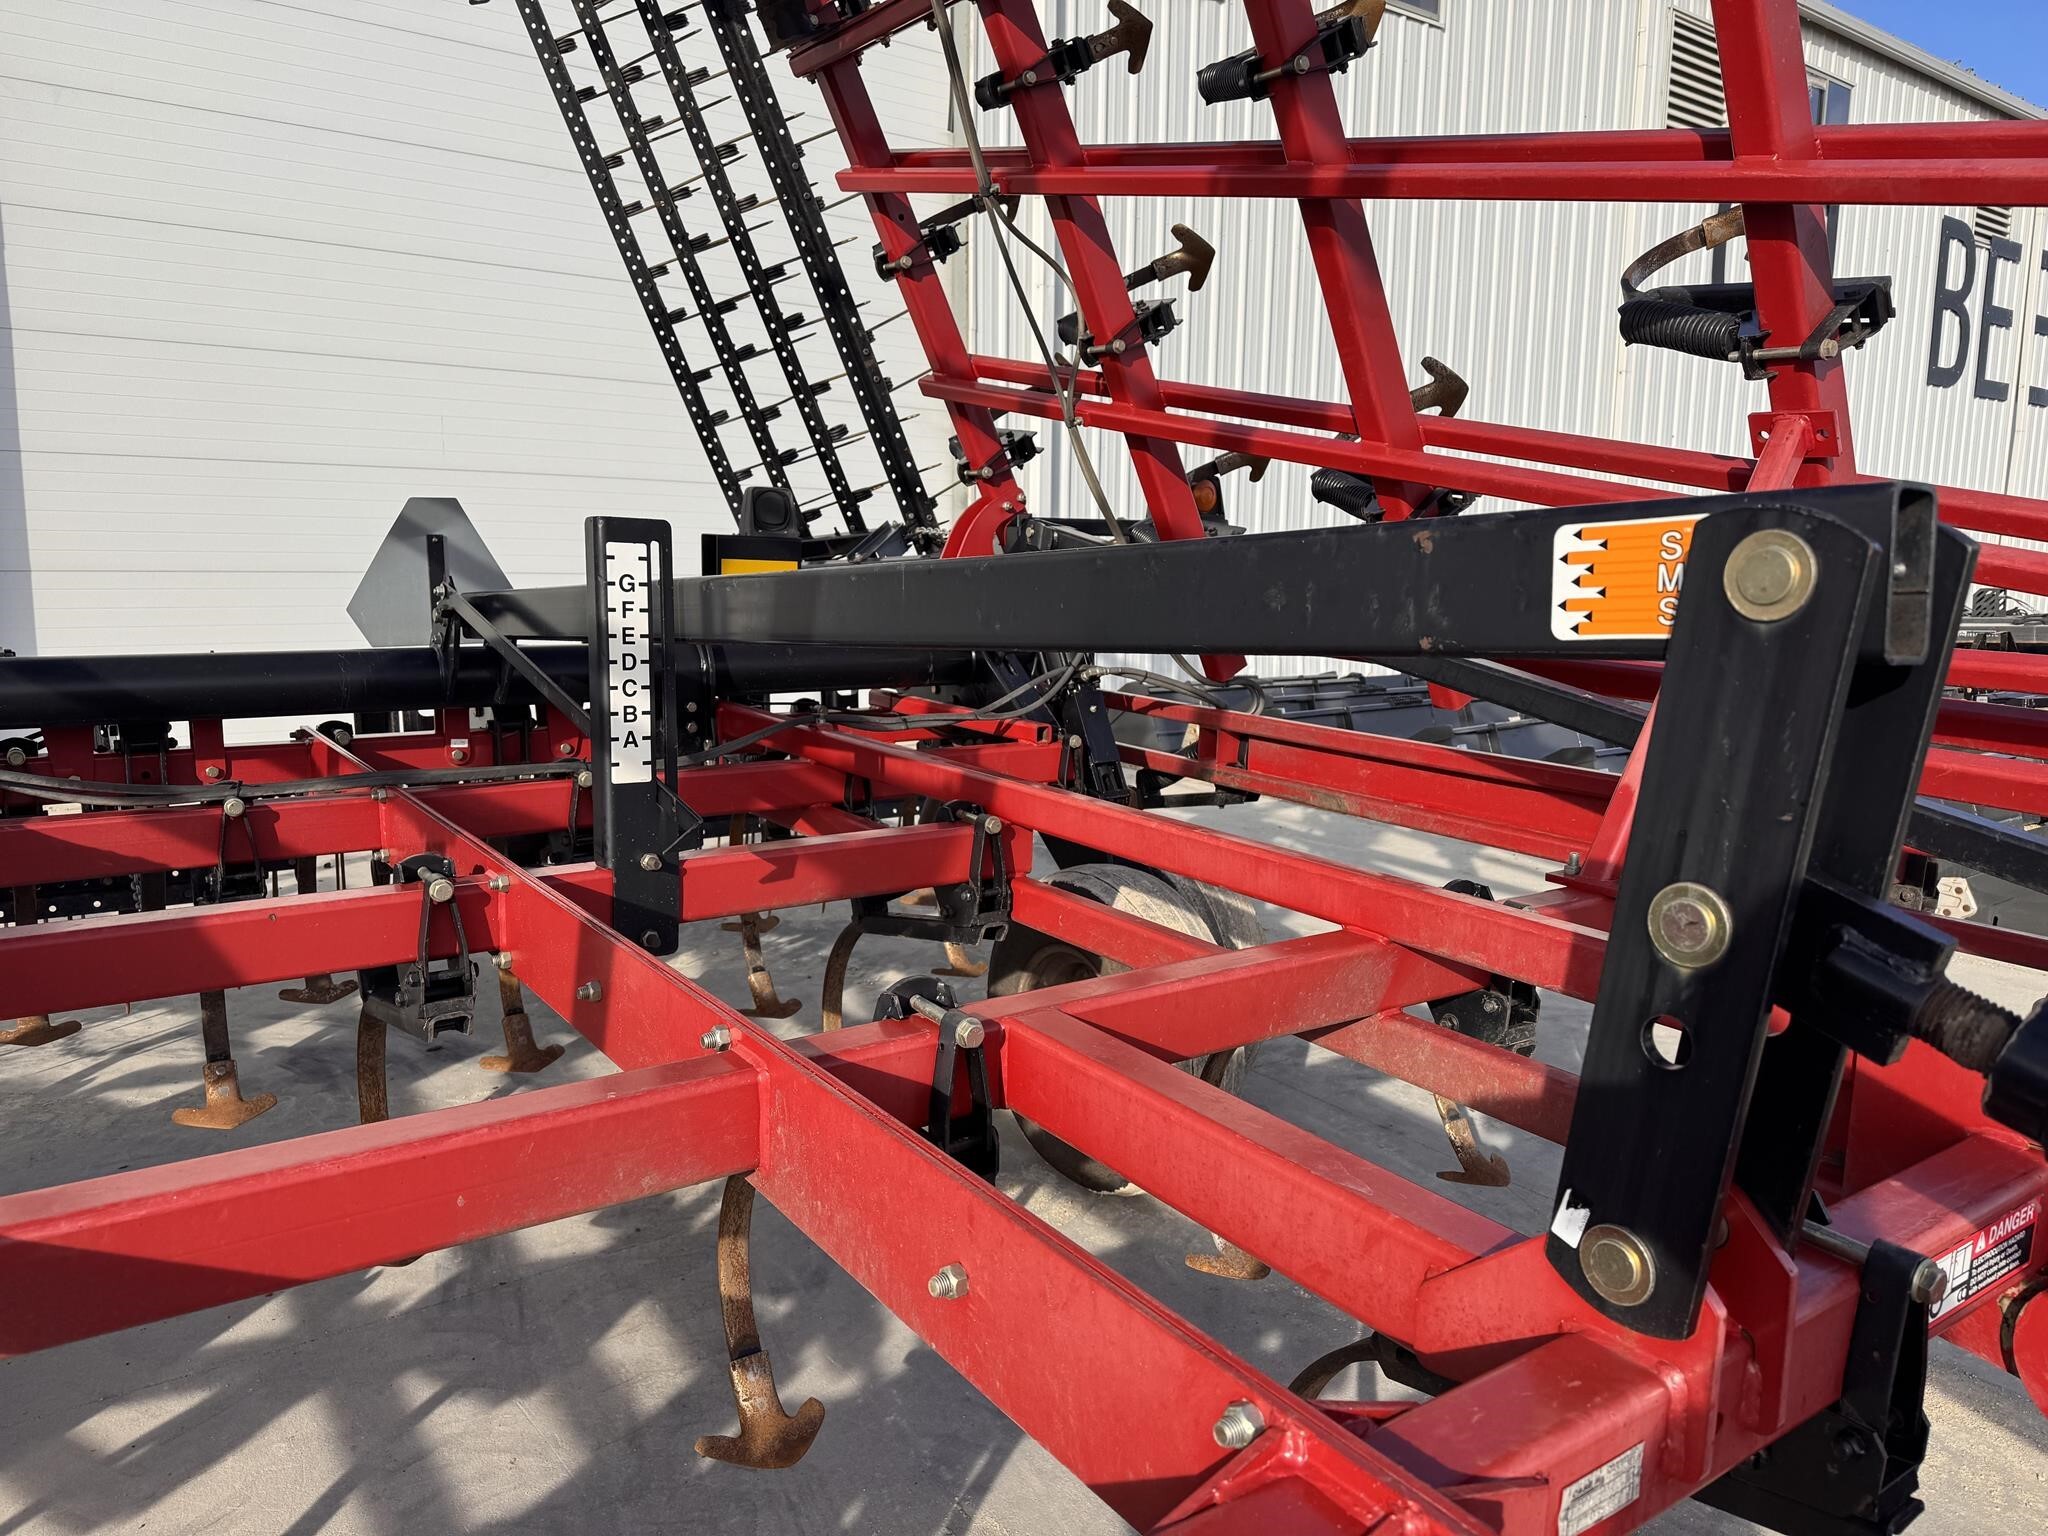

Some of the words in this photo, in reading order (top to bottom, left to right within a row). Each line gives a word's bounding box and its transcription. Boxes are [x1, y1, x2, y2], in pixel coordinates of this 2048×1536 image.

[618, 573, 636, 593] G
[621, 601, 635, 619] F
[621, 627, 636, 646] E
[622, 653, 638, 671] D
[622, 679, 638, 698] C
[623, 705, 638, 723] B
[623, 730, 639, 748] A
[1988, 1205, 2035, 1245] DANGER
